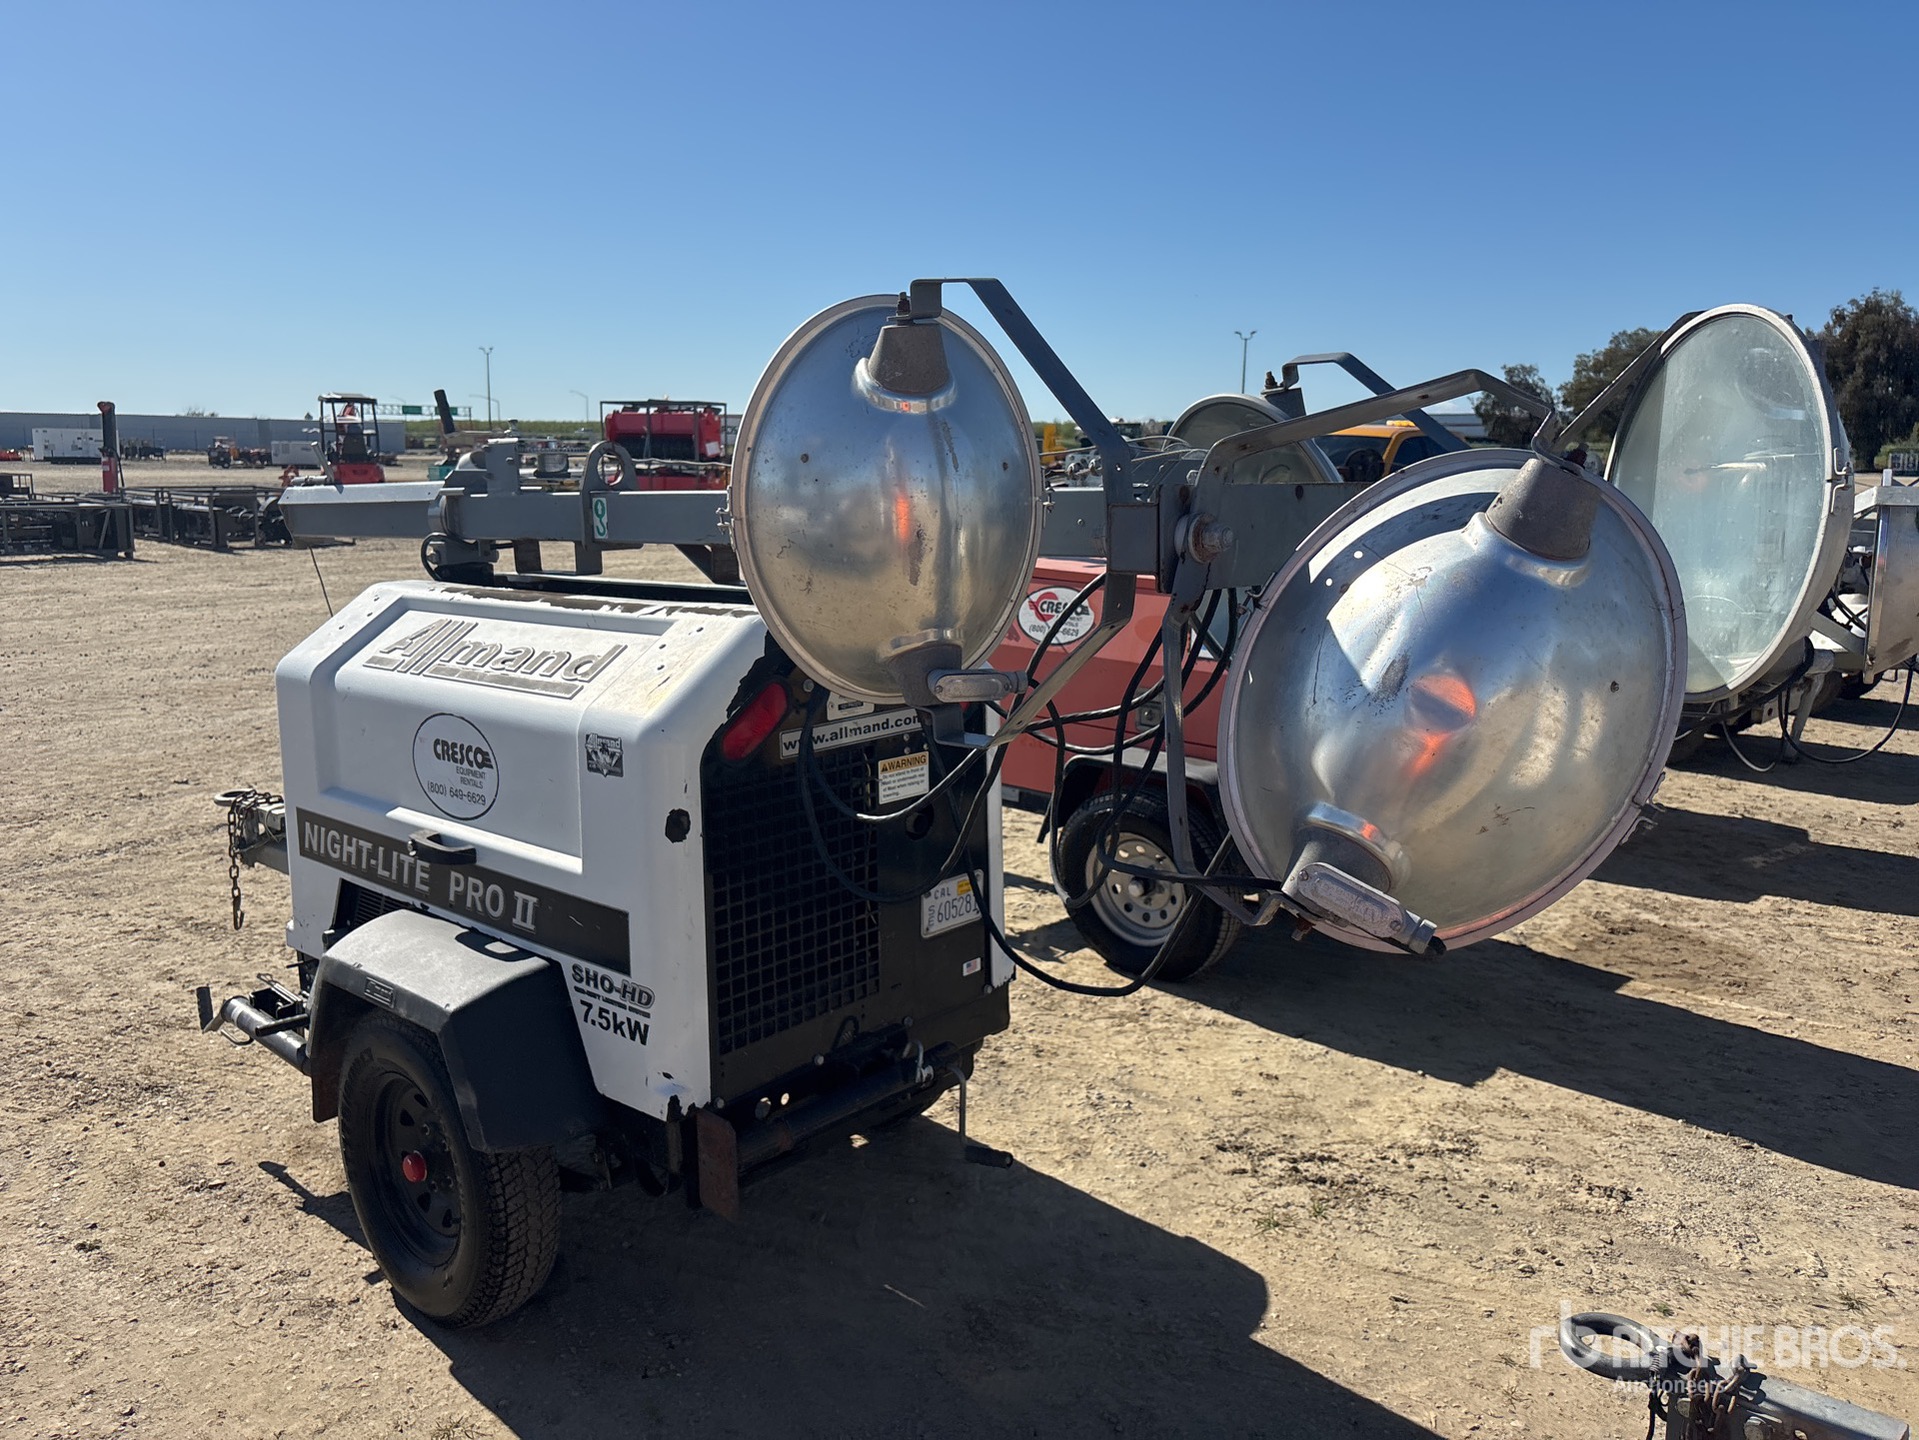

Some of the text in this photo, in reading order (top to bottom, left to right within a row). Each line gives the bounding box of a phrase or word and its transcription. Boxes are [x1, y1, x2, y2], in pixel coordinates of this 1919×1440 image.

[379, 618, 628, 684] Allmand
[433, 738, 494, 770] CRESCO
[887, 754, 926, 769] WARNING
[456, 766, 486, 780] EQUIPMENT
[460, 776, 484, 790] RENTALS
[427, 780, 486, 806] (800) 649-6629
[303, 820, 540, 933] NIGHT-LITE PRO II
[934, 887, 951, 900] CAL
[572, 963, 656, 1010] SHO-HD
[580, 999, 650, 1046] 7.5kW
